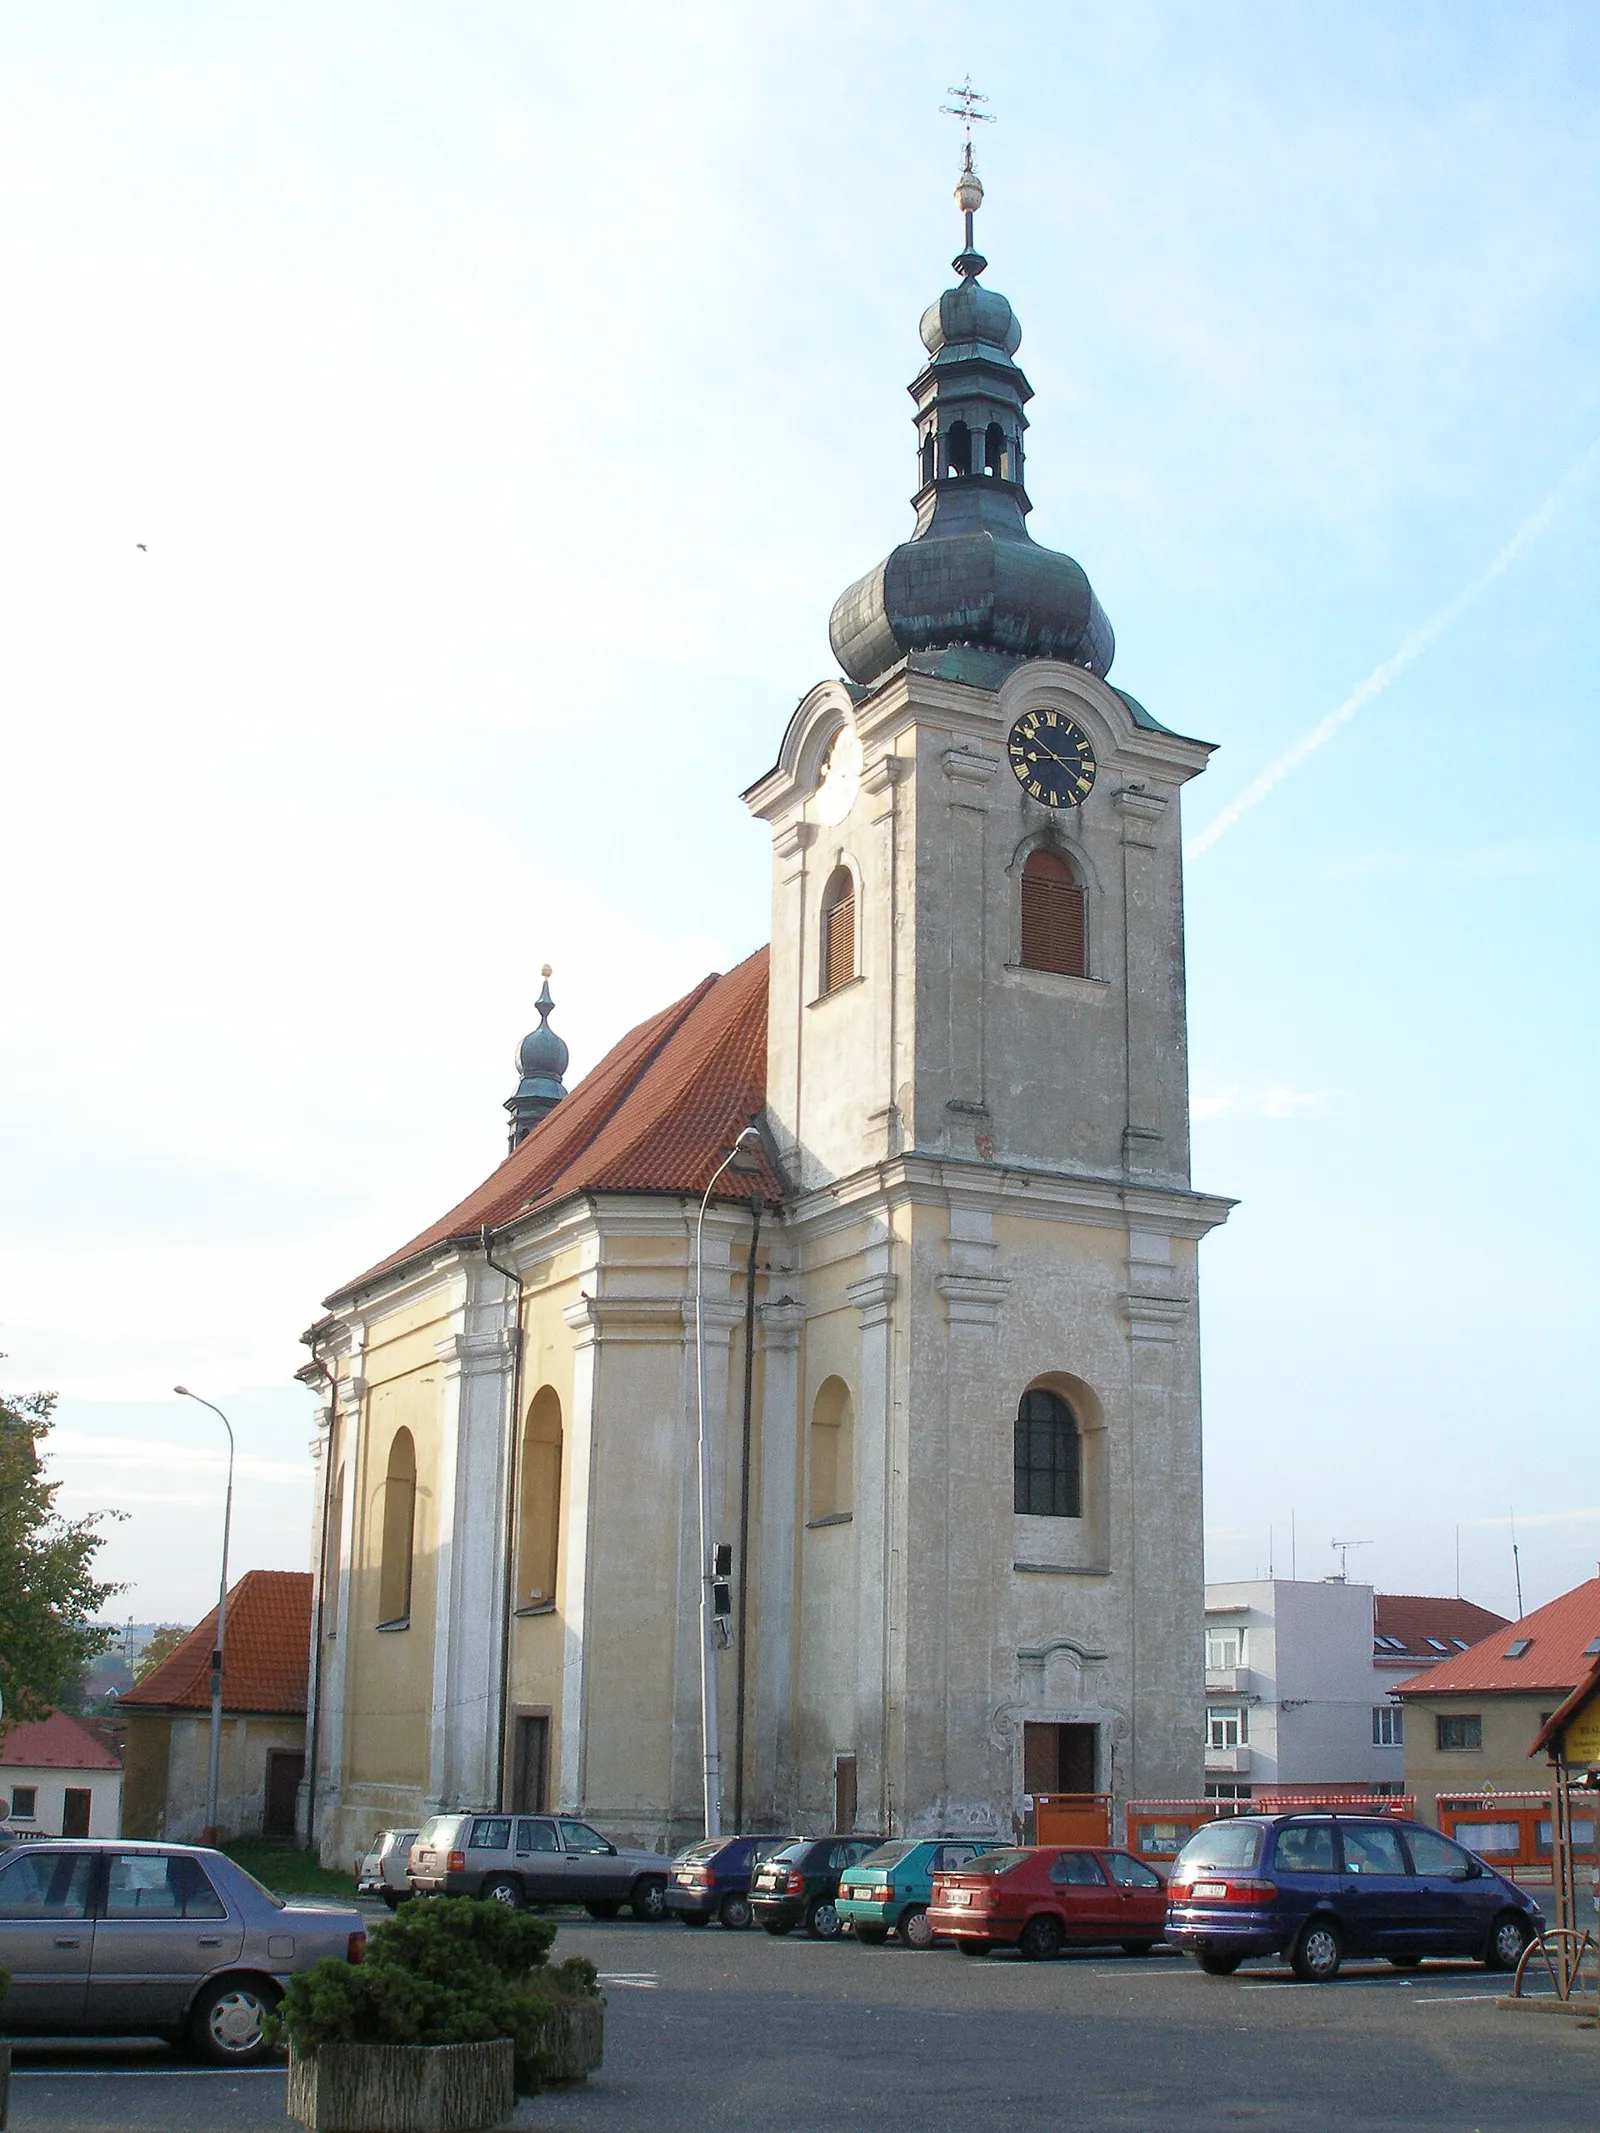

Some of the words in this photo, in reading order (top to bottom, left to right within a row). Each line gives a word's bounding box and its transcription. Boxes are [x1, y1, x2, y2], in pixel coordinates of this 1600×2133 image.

[1045, 711, 1057, 727] XII
[1065, 722, 1074, 735] I
[1076, 741, 1090, 751] II
[1081, 761, 1095, 772] III
[1050, 790, 1058, 806] VI
[1068, 790, 1077, 804] V
